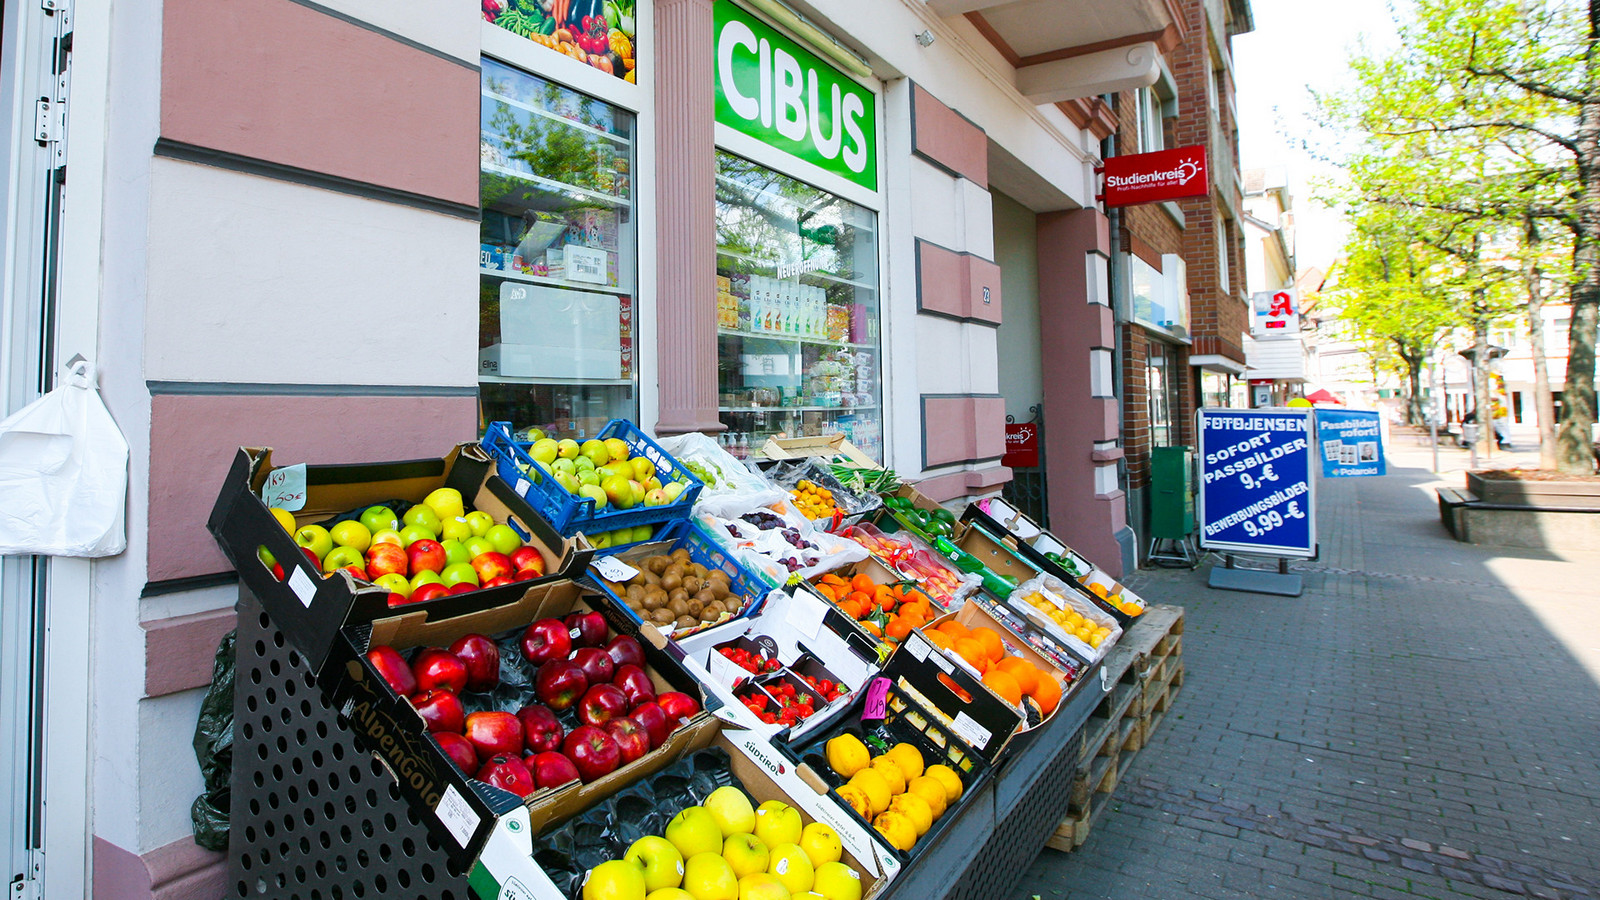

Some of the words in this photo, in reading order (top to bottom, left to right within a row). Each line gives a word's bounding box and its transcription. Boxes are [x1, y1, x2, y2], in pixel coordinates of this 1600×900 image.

[717, 20, 867, 173] CIBUS
[1107, 167, 1186, 187] Studienkreis
[1320, 418, 1378, 430] Passbilder
[1339, 427, 1379, 438] sofort!
[1206, 432, 1272, 465] SOFORT
[1340, 467, 1378, 476] Polaroid
